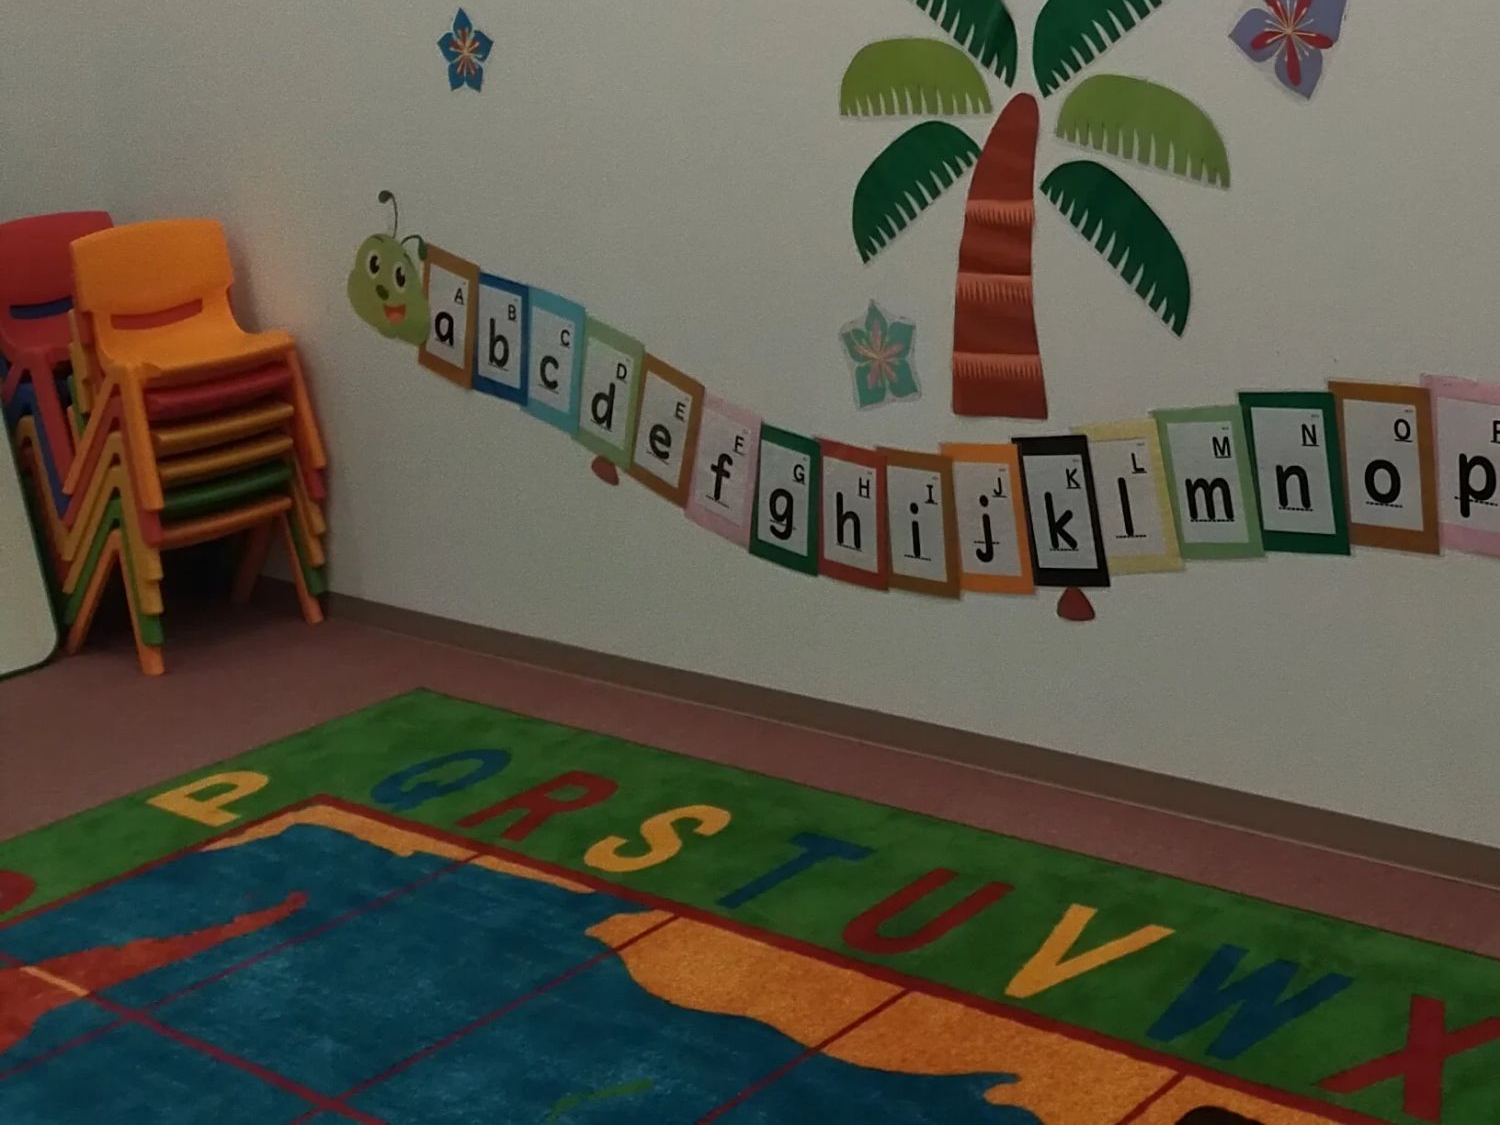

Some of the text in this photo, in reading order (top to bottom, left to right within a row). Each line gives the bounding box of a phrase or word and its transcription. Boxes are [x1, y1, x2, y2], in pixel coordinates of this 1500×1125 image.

[454, 287, 464, 304] A
[508, 304, 517, 321] B
[434, 311, 454, 346] a
[489, 318, 509, 368] b
[560, 329, 571, 347] C
[540, 355, 559, 389] c
[616, 362, 627, 380] D
[591, 382, 616, 430] d
[674, 401, 686, 421] E
[649, 423, 672, 460] e
[733, 435, 745, 454] F
[1212, 436, 1231, 458] M
[1301, 424, 1317, 446] N
[1393, 418, 1411, 441] O
[710, 453, 733, 502] f
[793, 464, 805, 483] G
[1065, 468, 1080, 489] K
[1131, 452, 1145, 473] L
[858, 477, 870, 498] H
[925, 484, 935, 504] I
[993, 477, 1002, 497] J
[1185, 477, 1234, 521] m
[1275, 464, 1312, 509] n
[1364, 459, 1401, 504] o
[1458, 453, 1497, 518] p
[769, 488, 794, 540] g
[836, 491, 861, 550] h
[1044, 491, 1078, 550] k
[1117, 477, 1134, 537] l
[910, 502, 921, 558] i
[976, 494, 994, 563] j
[146, 769, 270, 828] P
[370, 748, 512, 810] Q
[455, 770, 619, 842] R
[583, 804, 733, 872] S
[716, 831, 876, 909] T
[842, 868, 1015, 954] U
[1004, 903, 1176, 999] V
[1144, 943, 1355, 1061] W
